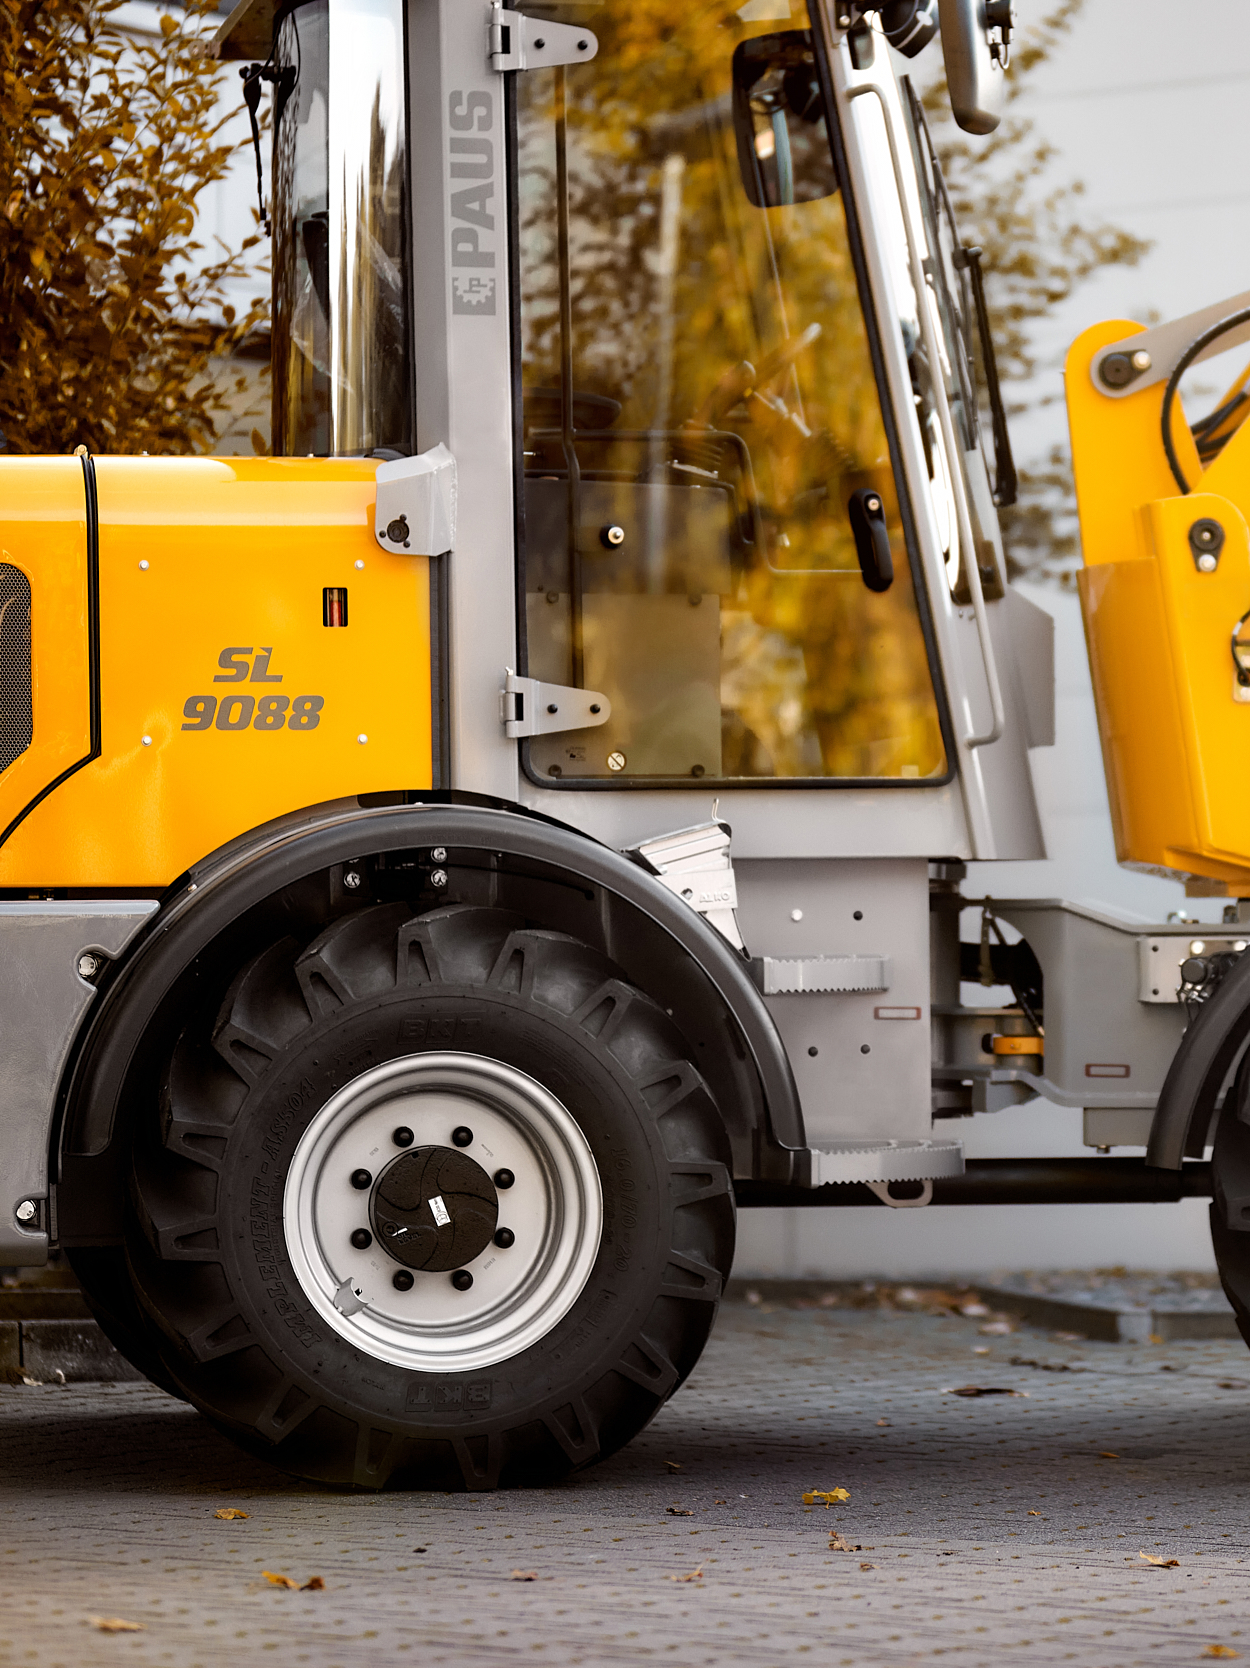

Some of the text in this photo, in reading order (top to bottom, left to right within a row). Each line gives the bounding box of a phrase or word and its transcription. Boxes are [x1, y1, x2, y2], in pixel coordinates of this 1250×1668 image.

[449, 90, 495, 268] PAUS
[213, 647, 283, 682] SL
[181, 695, 324, 731] 9088
[399, 1018, 483, 1044] BKT
[409, 1383, 491, 1408] BKT
